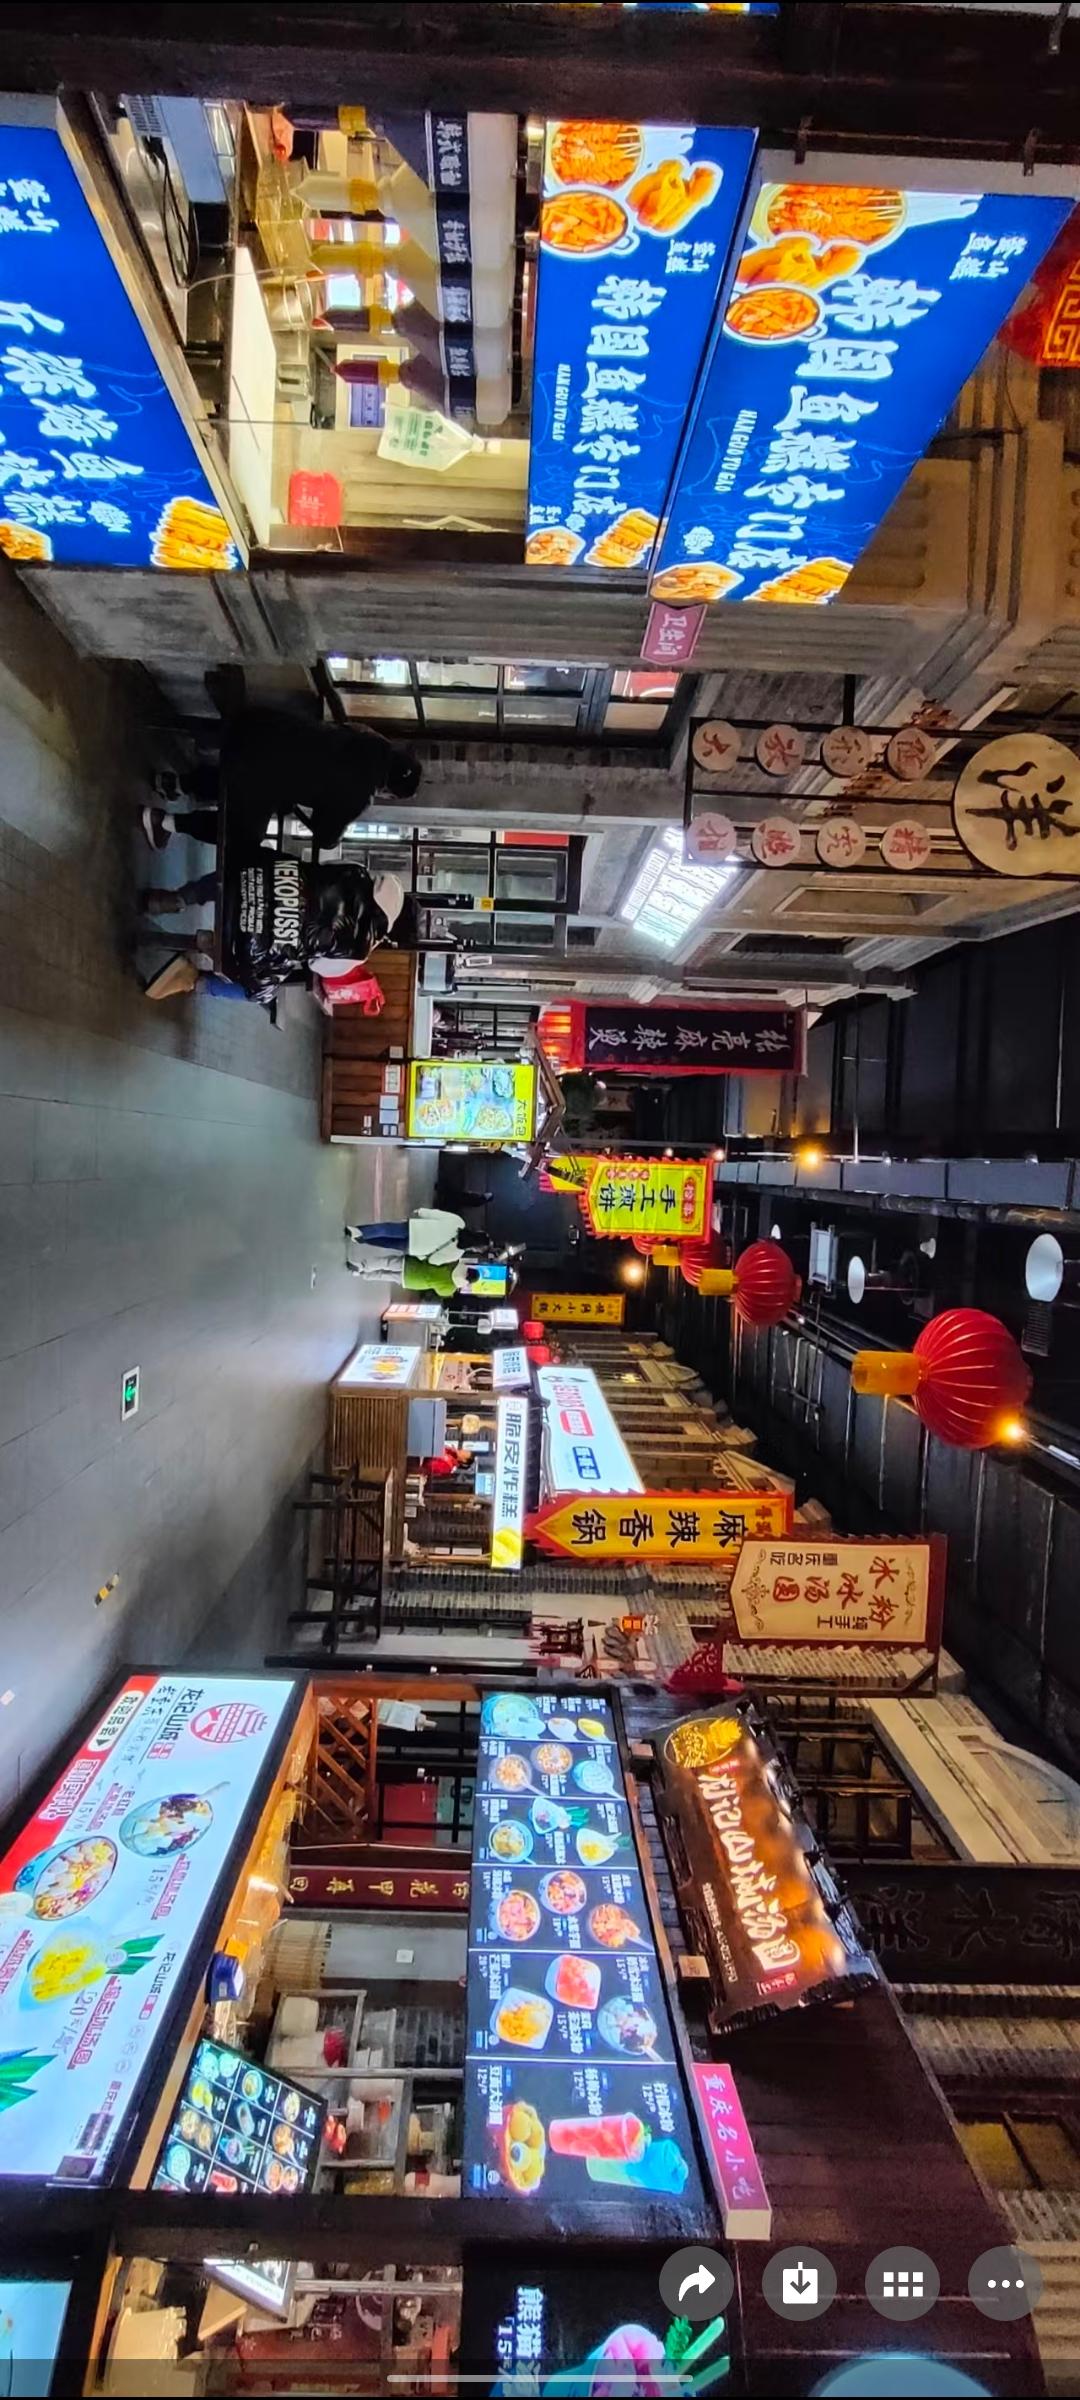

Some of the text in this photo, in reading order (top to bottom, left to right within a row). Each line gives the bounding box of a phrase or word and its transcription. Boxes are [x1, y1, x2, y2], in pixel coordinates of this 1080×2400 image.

[551, 363, 571, 441] HAN GUO YU GAO
[571, 275, 668, 515] 韩国鱼糕专门店
[714, 410, 758, 492] HAN GUO YU GAO
[653, 613, 688, 656] 卫生间
[966, 761, 1080, 851] 洋
[588, 1023, 791, 1053] 张亮麻辣烫
[598, 1183, 676, 1215] 手工煎饼
[501, 1411, 523, 1518] 脆皮炸糕
[570, 1508, 746, 1548] 麻辣香锅
[770, 1552, 838, 1567] 重庆名吃
[817, 1615, 868, 1630] 纯手工
[868, 1556, 900, 1631] 冰粉
[701, 2074, 756, 2201] 重庆名小吃
